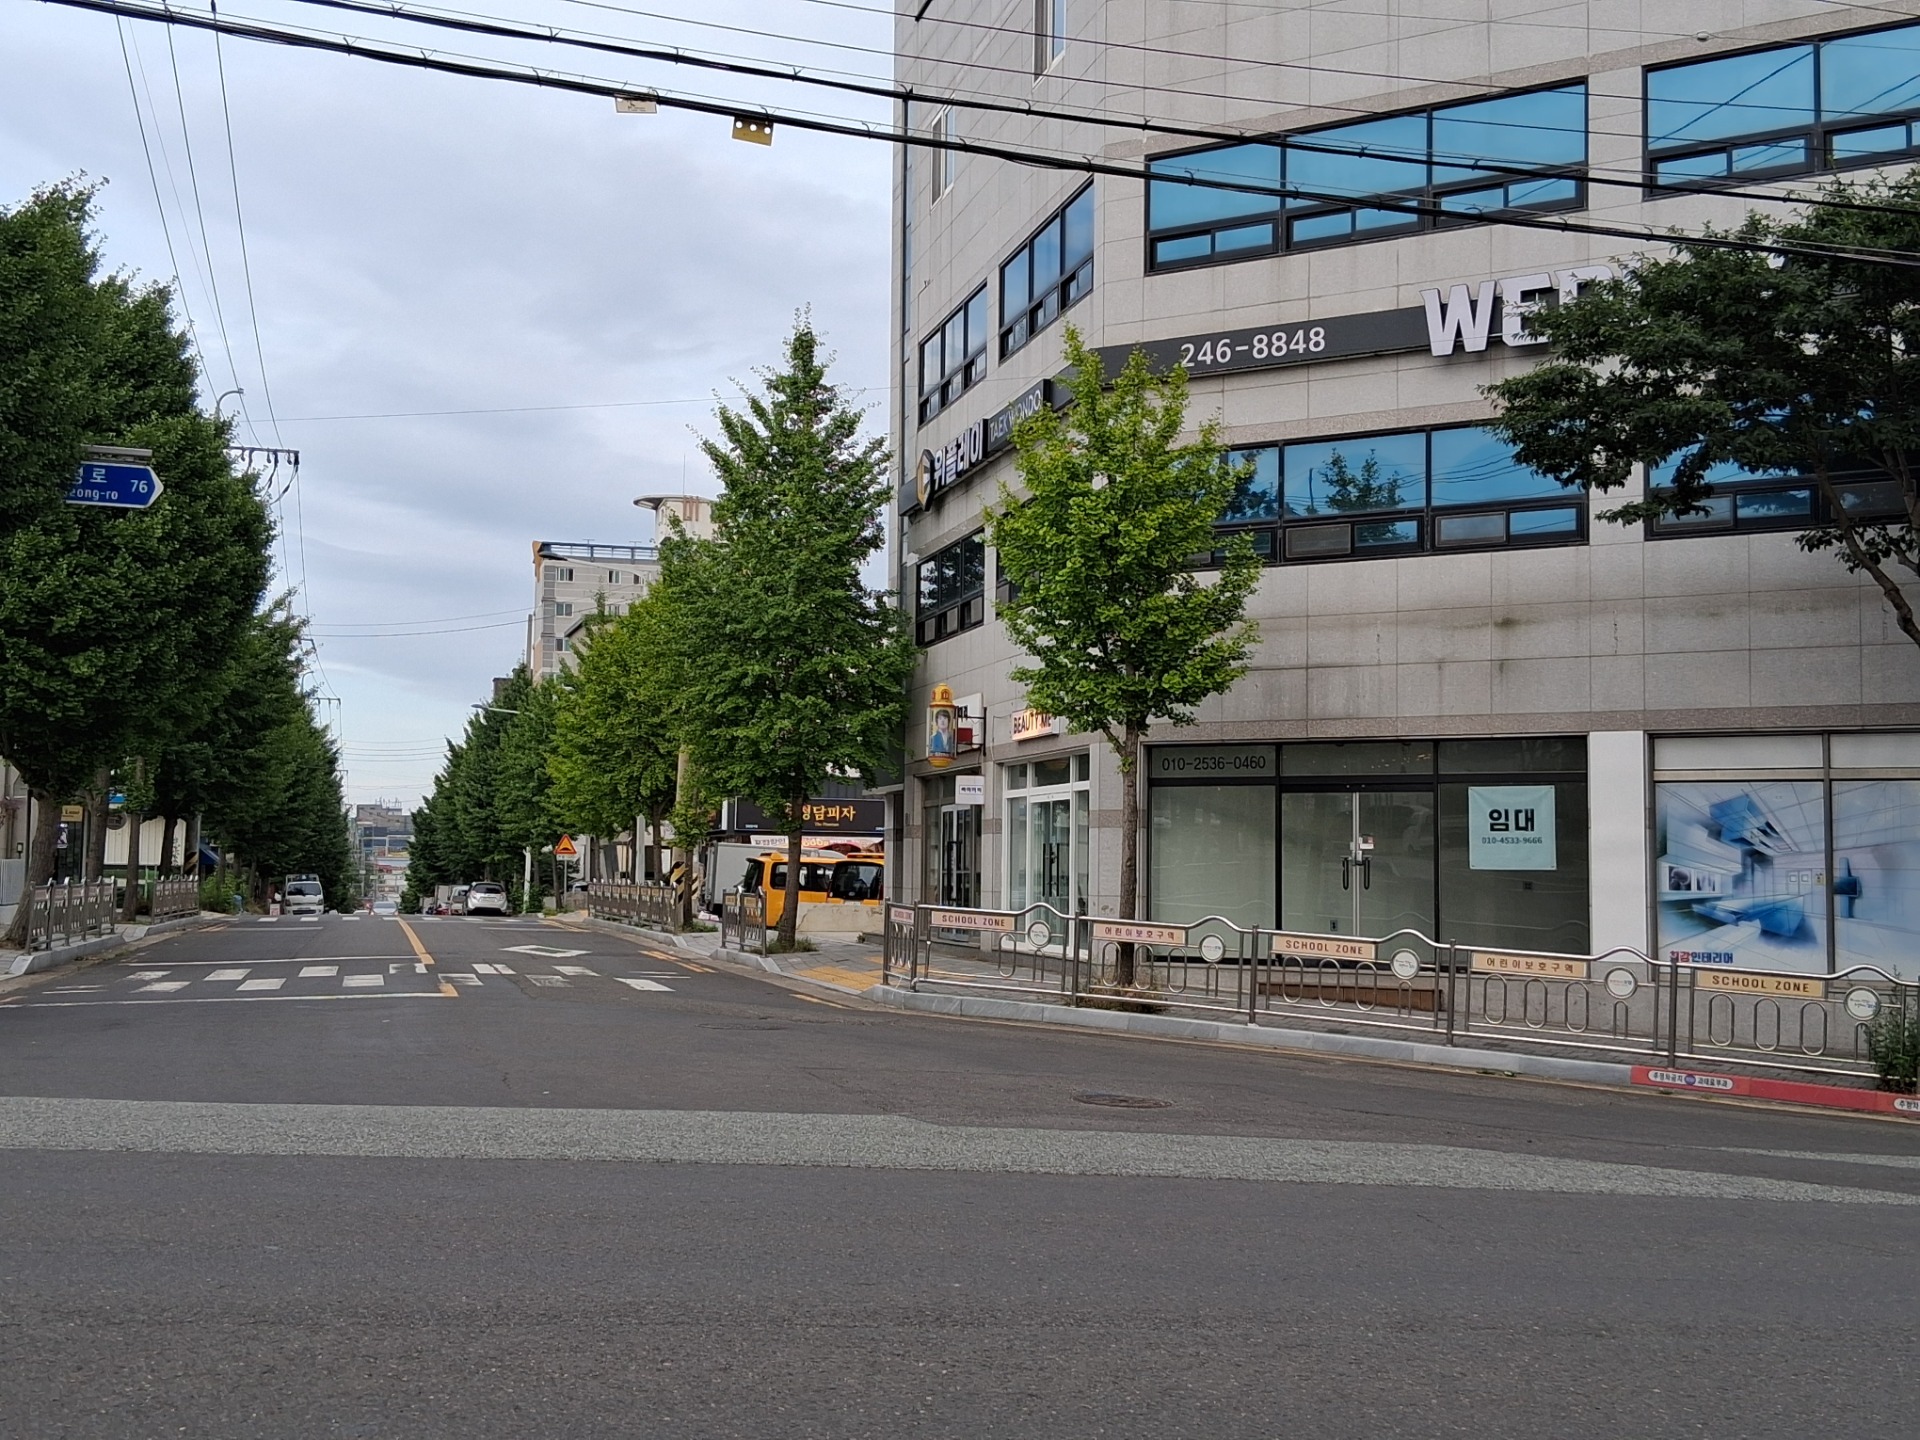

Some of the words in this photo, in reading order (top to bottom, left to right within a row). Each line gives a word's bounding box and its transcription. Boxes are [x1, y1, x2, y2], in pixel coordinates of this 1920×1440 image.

[1180, 327, 1325, 367] 246-8848
[934, 420, 982, 491] 위플레이
[64, 488, 118, 500] eong-ro
[130, 480, 148, 493] 76
[1013, 711, 1039, 733] BEAUTY
[1162, 756, 1266, 771] 010-2536-0460
[1488, 808, 1535, 832] 임대
[942, 915, 978, 925] SCHOOL
[983, 918, 1005, 927] ZONE
[1104, 926, 1175, 941] 어린이보호구역
[1285, 940, 1329, 951] SCHOOL
[1336, 944, 1363, 954] ZONE
[1486, 957, 1574, 973] 어린이보호구역
[1712, 975, 1767, 989] SCHOOL
[1775, 980, 1810, 993] ZONE
